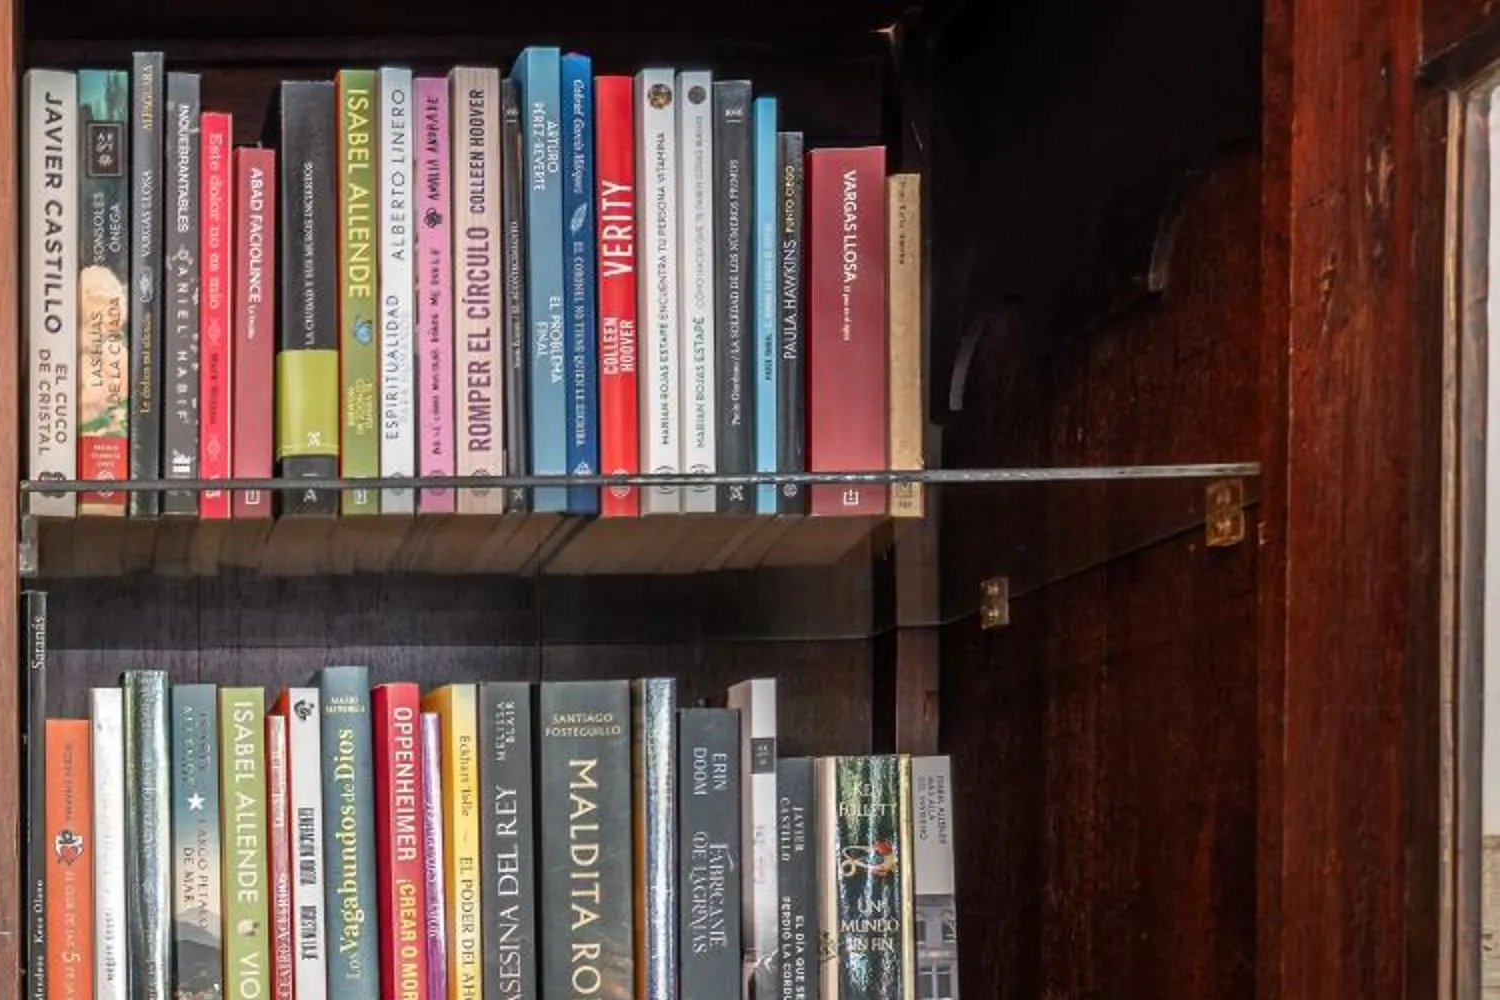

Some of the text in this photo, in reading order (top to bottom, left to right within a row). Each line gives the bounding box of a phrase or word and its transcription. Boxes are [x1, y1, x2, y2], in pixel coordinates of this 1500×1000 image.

[177, 104, 190, 232] INQUEBRANTABLES
[470, 89, 484, 213] COLLEEN HOOVER
[547, 121, 559, 172] ARTURO
[348, 89, 368, 297] ISABEL ALLENDE
[391, 89, 404, 261] ALBERTO LINERO
[44, 91, 64, 334] JAVIER CASTILLO
[94, 192, 104, 262] SONSOLES
[209, 133, 222, 273] Este dolor no es
[602, 181, 632, 276] VERITY
[843, 171, 856, 283] VARGAS LLOSA
[141, 211, 151, 256] VARGAS
[249, 167, 262, 303] ABAD FACIOLINCE
[783, 240, 796, 358] PAULA HAWKINS
[177, 250, 190, 419] DANIEL HABIF
[463, 227, 491, 451] ROMPER EL CÍRCULO
[536, 321, 547, 358] FINAL
[549, 296, 562, 383] EL PROBLEMA
[604, 318, 619, 374] COLLEEN
[620, 321, 633, 371] HOOVER
[92, 360, 103, 386] LAS
[110, 361, 120, 379] LA
[386, 296, 399, 440] ESPIRITUALIDAD
[38, 350, 51, 455] DE CRISTAL
[54, 363, 67, 443] EL CUCO
[30, 616, 45, 669] Satanás
[545, 726, 621, 737] POSTEGUILLO
[549, 712, 613, 724] SANTIAGO
[334, 729, 359, 782] Dios
[459, 735, 472, 783] Eckhart
[693, 748, 707, 795] DOOM
[713, 753, 727, 790] ERIN
[233, 702, 258, 902] ISABEL ALLENDE
[345, 784, 357, 800] de
[394, 707, 416, 861] OPPENHEIMER
[495, 782, 517, 835] REY
[569, 758, 601, 930] MALDITA
[780, 797, 791, 861] CASTILLO
[793, 807, 805, 852] JAVIER
[183, 847, 194, 902] DE MAR
[339, 803, 365, 952] Vagabundos
[459, 857, 473, 875] EL
[498, 844, 519, 895] DEL
[397, 879, 417, 941] ¡CREAR
[459, 879, 473, 934] PODER
[795, 915, 804, 929] EL
[841, 919, 900, 932] MUNDO
[858, 900, 882, 914] UN
[61, 952, 80, 962] 5
[400, 947, 417, 958] O
[461, 939, 475, 969] DEL
[782, 944, 793, 958] LA
[795, 958, 805, 982] QUE
[796, 985, 805, 1000] SE
